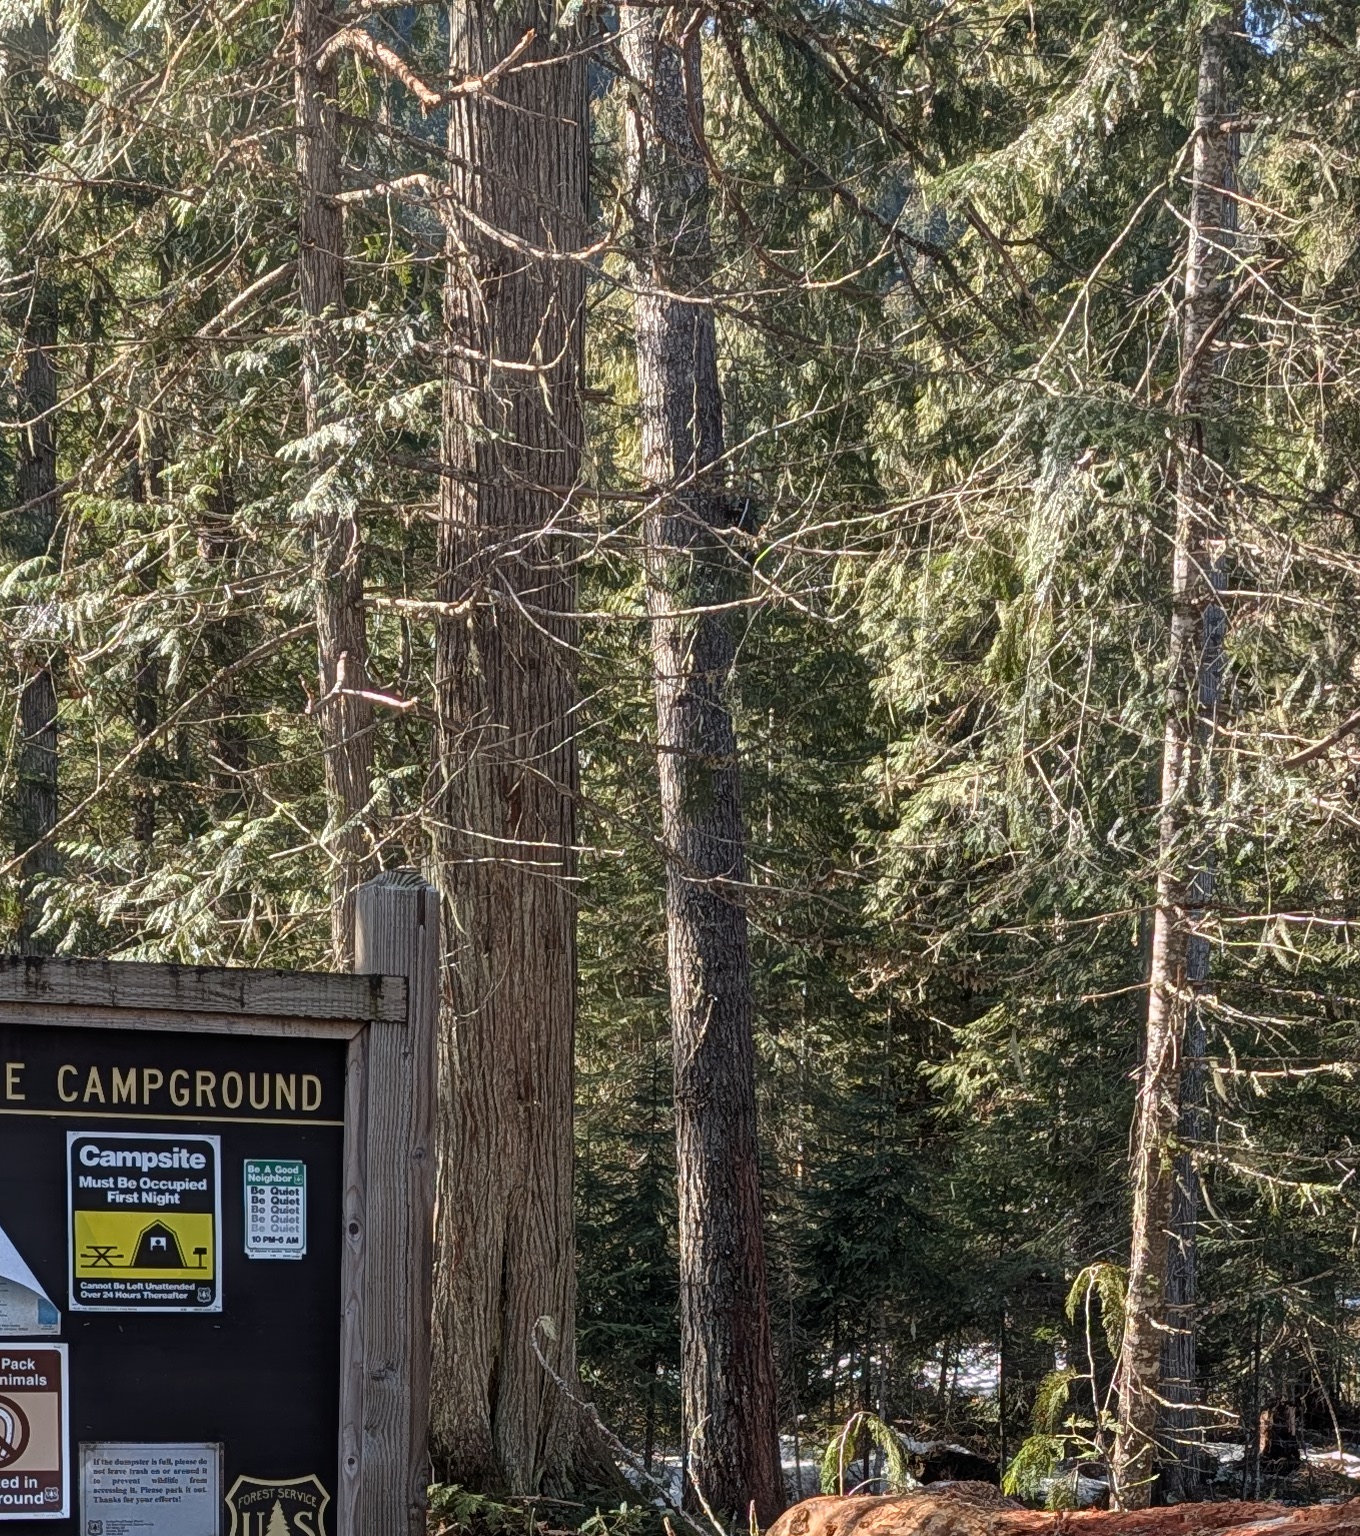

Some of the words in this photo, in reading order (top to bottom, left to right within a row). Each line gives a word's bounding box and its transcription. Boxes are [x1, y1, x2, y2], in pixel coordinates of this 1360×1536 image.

[57, 1064, 322, 1111] CAMPGROUND
[79, 1145, 206, 1172] Campsite
[248, 1165, 260, 1173] Be
[264, 1165, 271, 1173] A
[274, 1166, 298, 1174] Good
[248, 1174, 292, 1184] Neighbor
[79, 1176, 114, 1188] Must
[118, 1177, 137, 1188] Be
[140, 1177, 207, 1192] Occupied
[251, 1187, 265, 1195] Be
[270, 1187, 299, 1196] Quiet
[107, 1191, 139, 1203] First
[142, 1192, 180, 1206] Night
[251, 1196, 265, 1205] Be
[270, 1197, 300, 1205] Quiet
[251, 1206, 265, 1214] Be
[270, 1206, 300, 1214] Quiet
[251, 1215, 265, 1223] Be
[271, 1215, 300, 1224] Quiet
[271, 1224, 300, 1233] Quiet
[80, 1282, 112, 1290] Cannot
[145, 1283, 195, 1291] Unattended
[116, 1291, 141, 1299] Hours
[143, 1292, 188, 1300] Thereafter
[1, 1358, 35, 1370] Pack
[24, 1477, 38, 1489] in
[238, 1488, 275, 1509] FOREST
[277, 1488, 316, 1507] SERVICE
